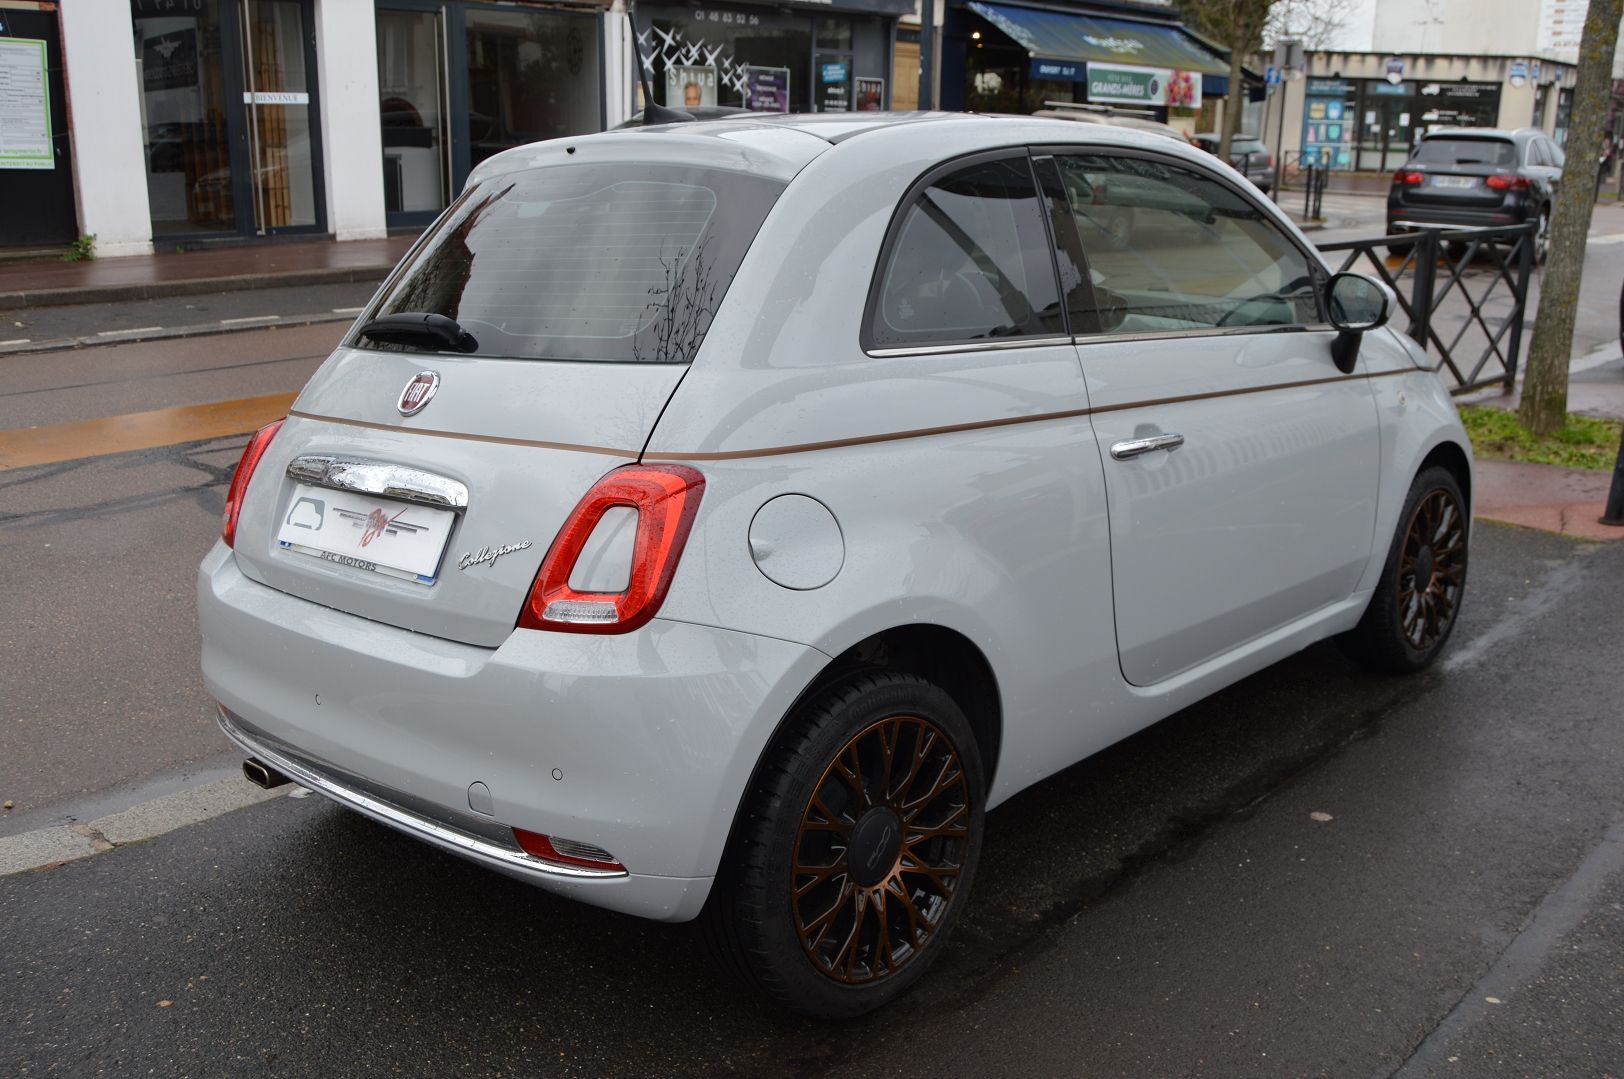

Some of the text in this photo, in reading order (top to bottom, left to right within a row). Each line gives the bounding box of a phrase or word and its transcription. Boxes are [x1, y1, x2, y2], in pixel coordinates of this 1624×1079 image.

[403, 382, 430, 403] FIAT
[320, 550, 377, 572] AFC MOTORS
[458, 539, 533, 571] Collezione
